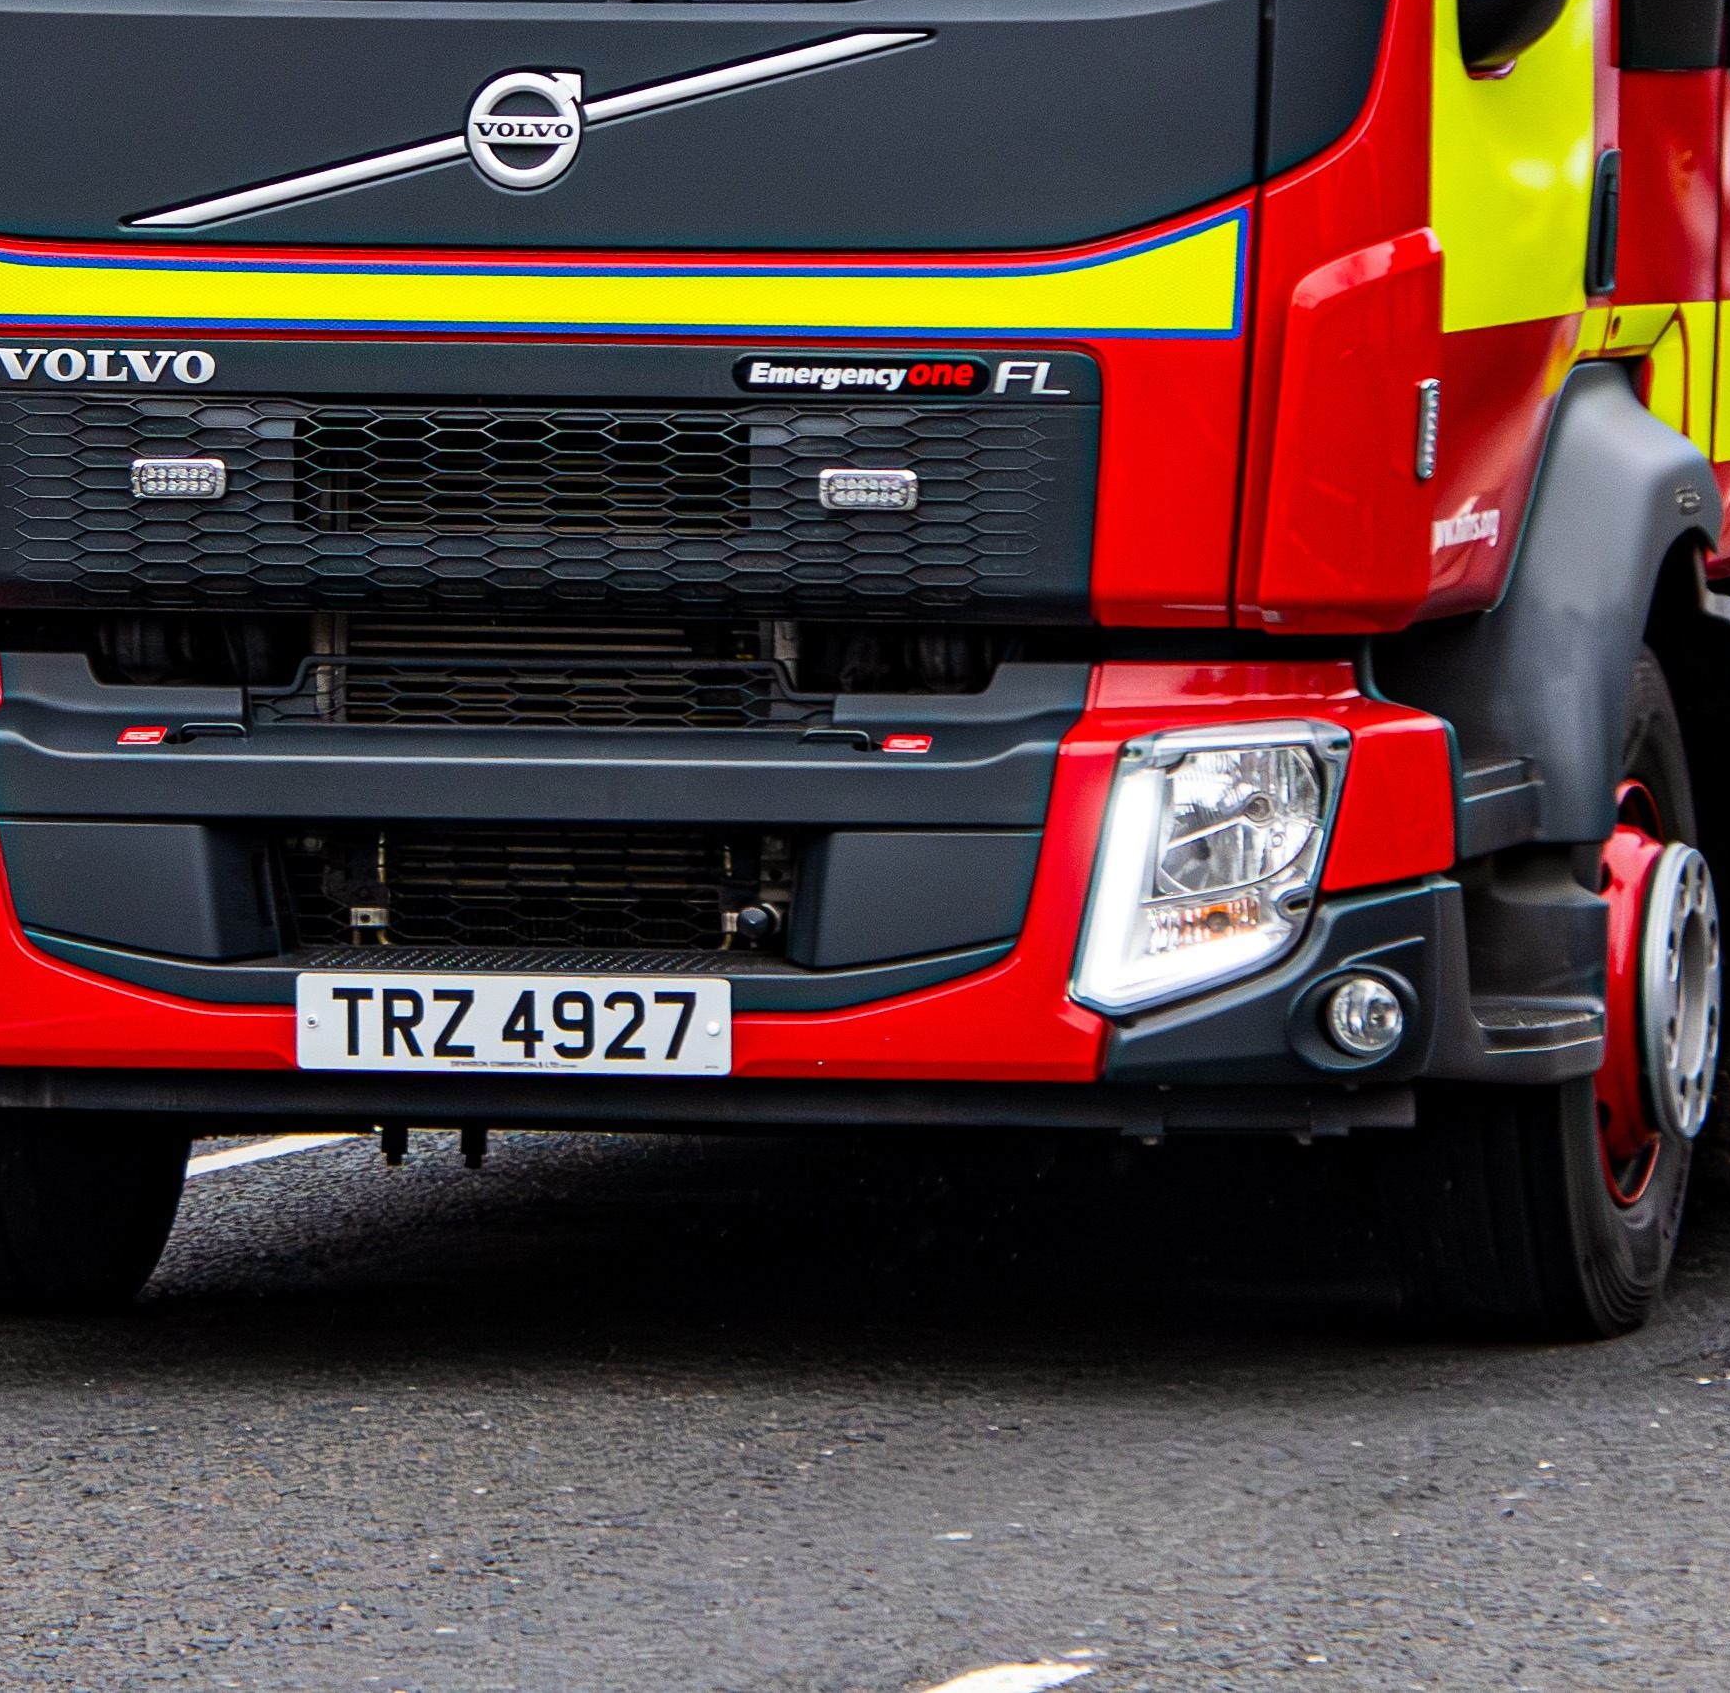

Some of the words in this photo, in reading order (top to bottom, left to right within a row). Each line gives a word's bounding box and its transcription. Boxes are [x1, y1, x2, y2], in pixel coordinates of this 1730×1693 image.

[473, 122, 574, 138] VOLVO
[993, 361, 1071, 394] FL
[332, 987, 475, 1058] TRZ
[502, 990, 697, 1060] 4927
